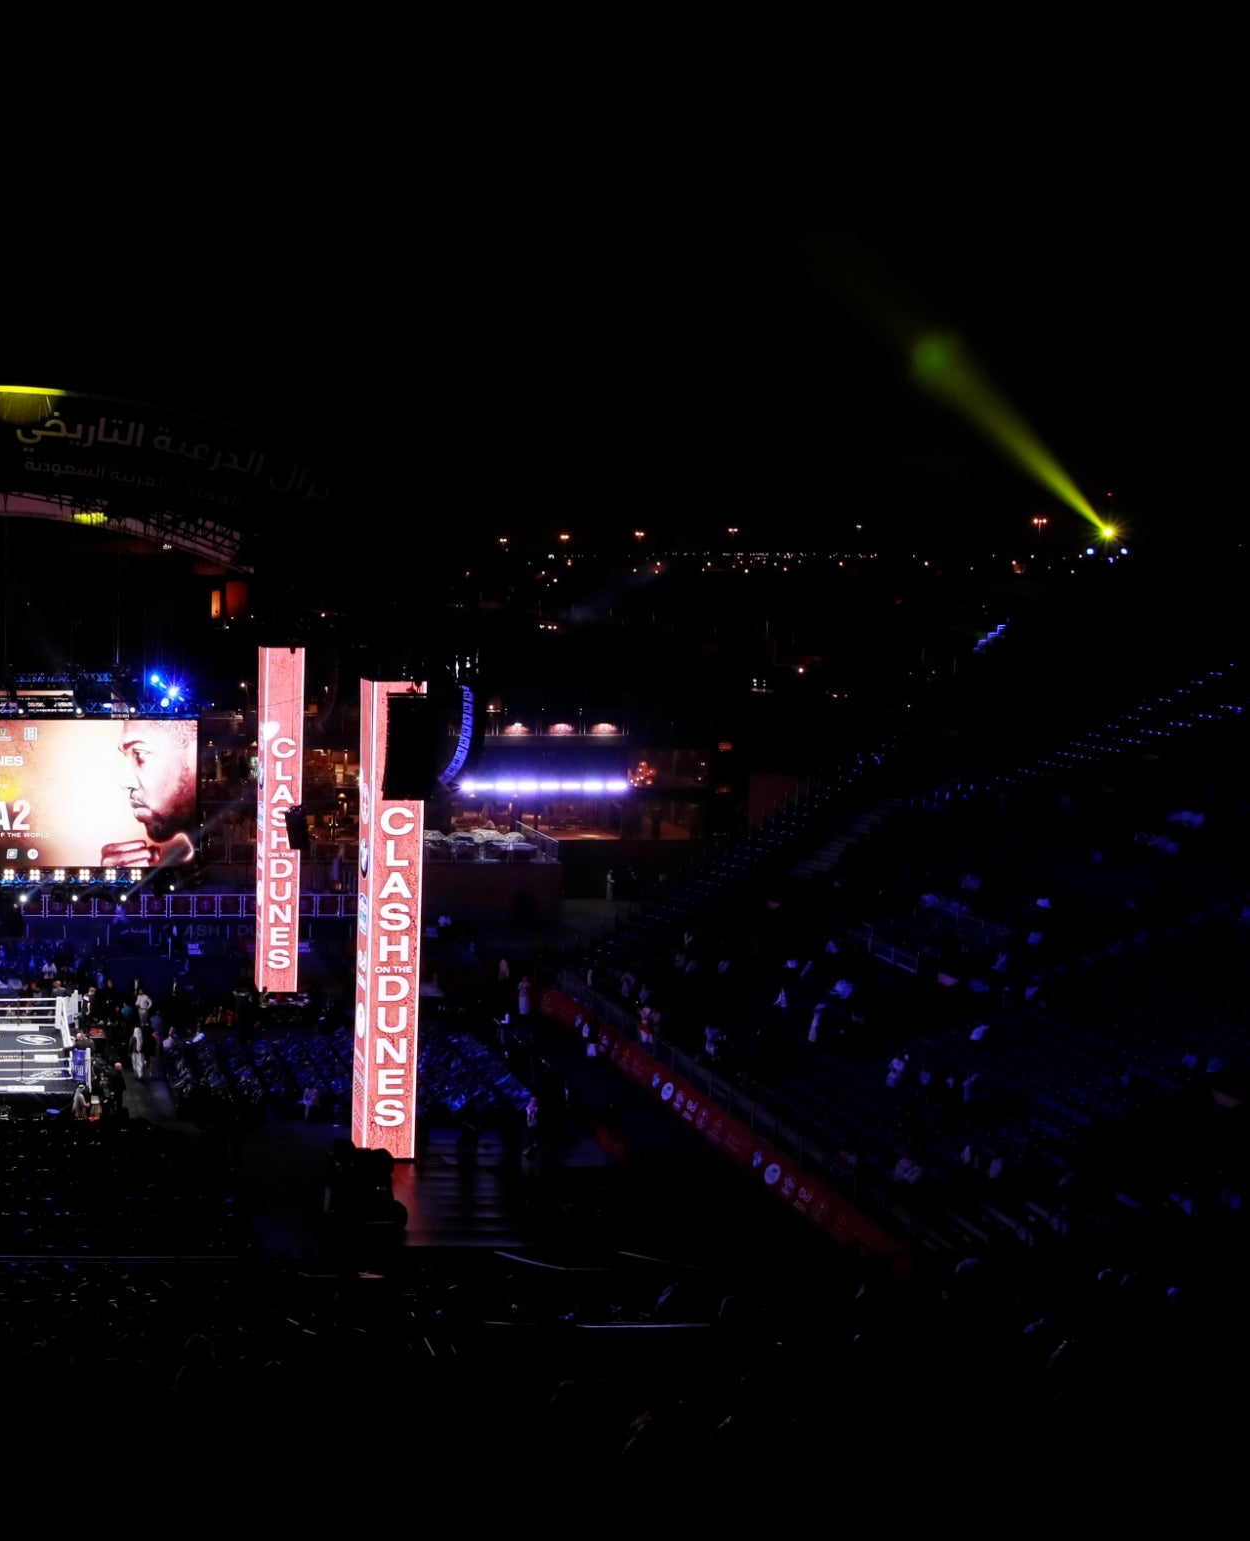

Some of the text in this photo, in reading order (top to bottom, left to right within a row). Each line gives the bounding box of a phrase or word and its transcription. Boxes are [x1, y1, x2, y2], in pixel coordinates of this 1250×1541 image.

[14, 410, 146, 454] التاريخي
[7, 831, 21, 839] THE
[23, 831, 51, 839] WORLD
[12, 800, 31, 831] 2
[379, 806, 416, 962] CLASH
[267, 859, 294, 969] DUNES
[374, 966, 413, 974] ON THE
[373, 975, 410, 1127] DUNES
